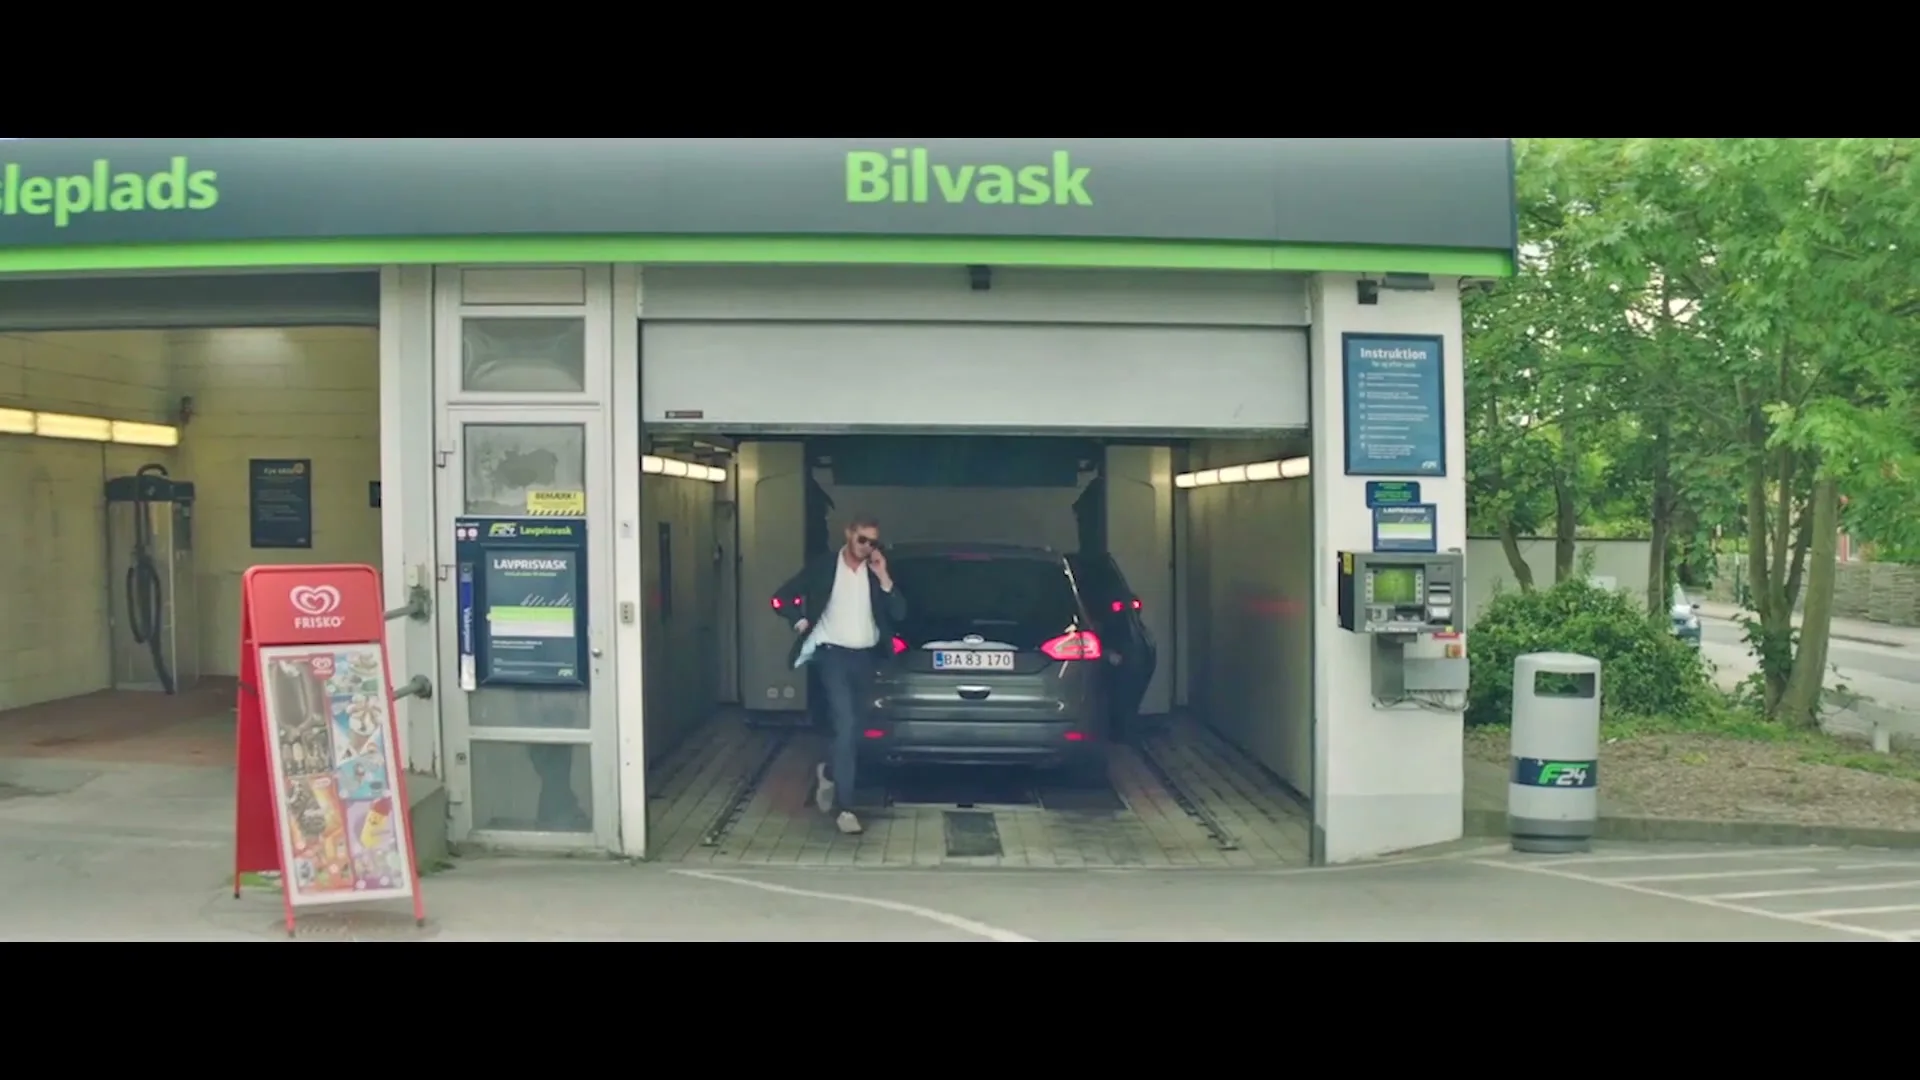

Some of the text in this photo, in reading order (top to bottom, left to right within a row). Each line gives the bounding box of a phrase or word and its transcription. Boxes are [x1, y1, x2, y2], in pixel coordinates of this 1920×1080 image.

[846, 148, 1093, 206] Bilvask
[0, 156, 218, 228] leplads
[1360, 347, 1427, 360] Instruktion
[520, 526, 572, 536] Lavprisvask
[494, 559, 567, 570] LAVPRISVASK
[294, 616, 342, 629] FRISKO
[944, 654, 1011, 666] BA 83 170
[1538, 762, 1590, 786] F24
